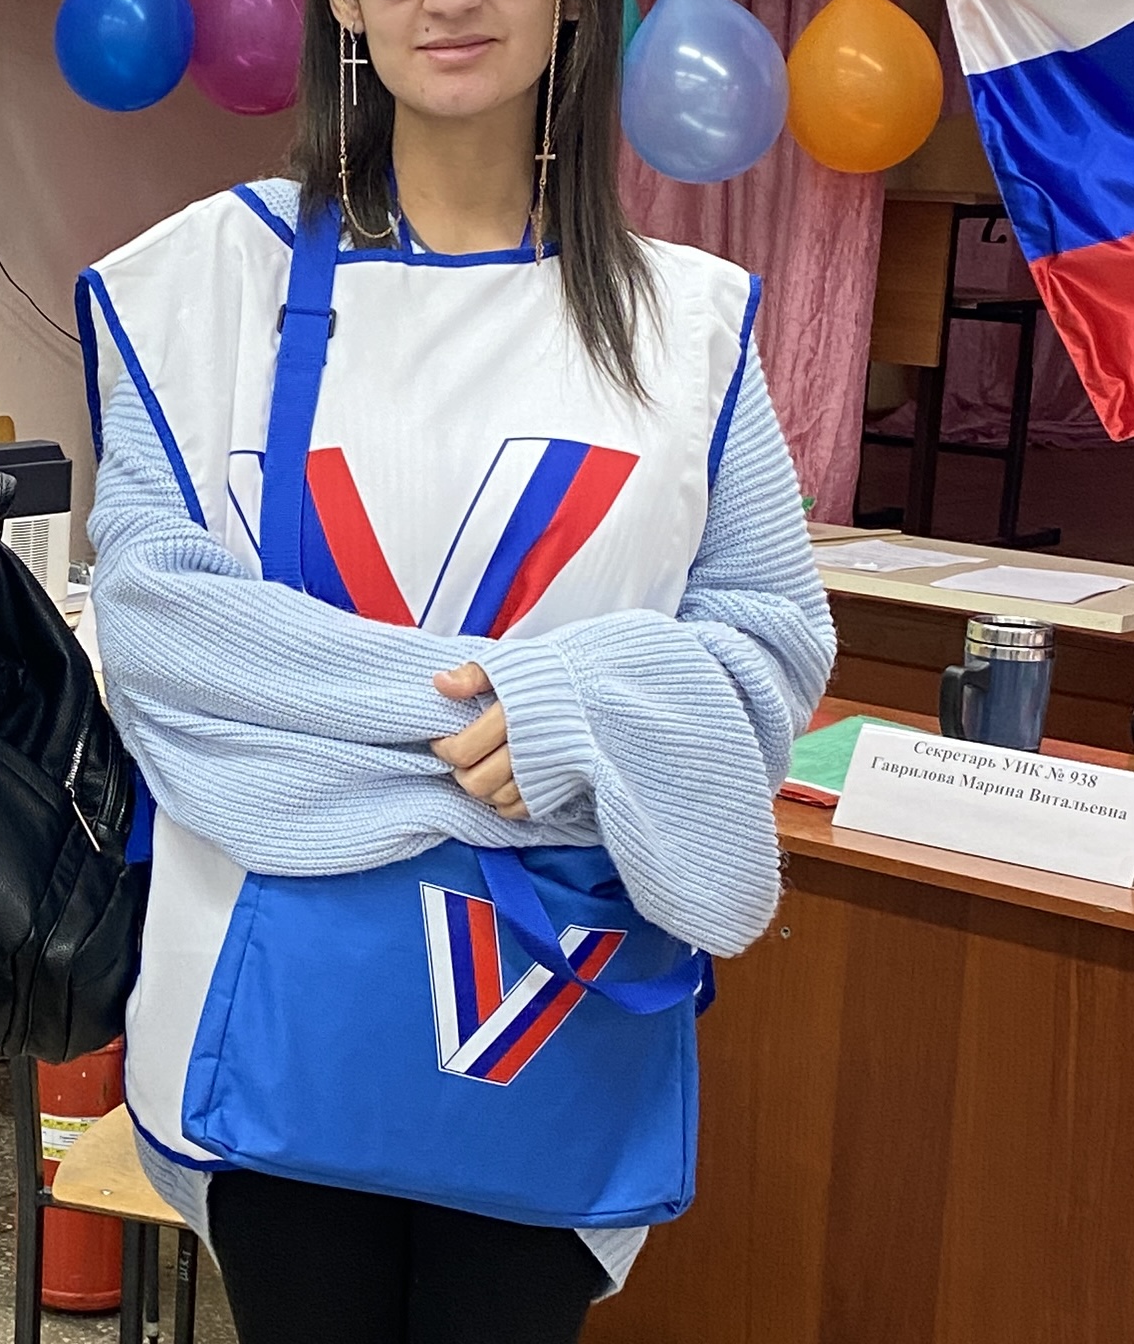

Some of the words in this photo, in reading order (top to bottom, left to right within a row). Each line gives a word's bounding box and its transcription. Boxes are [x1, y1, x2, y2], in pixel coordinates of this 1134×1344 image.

[871, 756, 955, 785] Гаврилова
[959, 774, 1024, 799] Марина
[1029, 788, 1127, 820] Витальевна
[913, 741, 997, 769] Секретарь
[1003, 757, 1043, 777] УИК
[1044, 766, 1065, 782] №
[1069, 771, 1099, 788] 938
